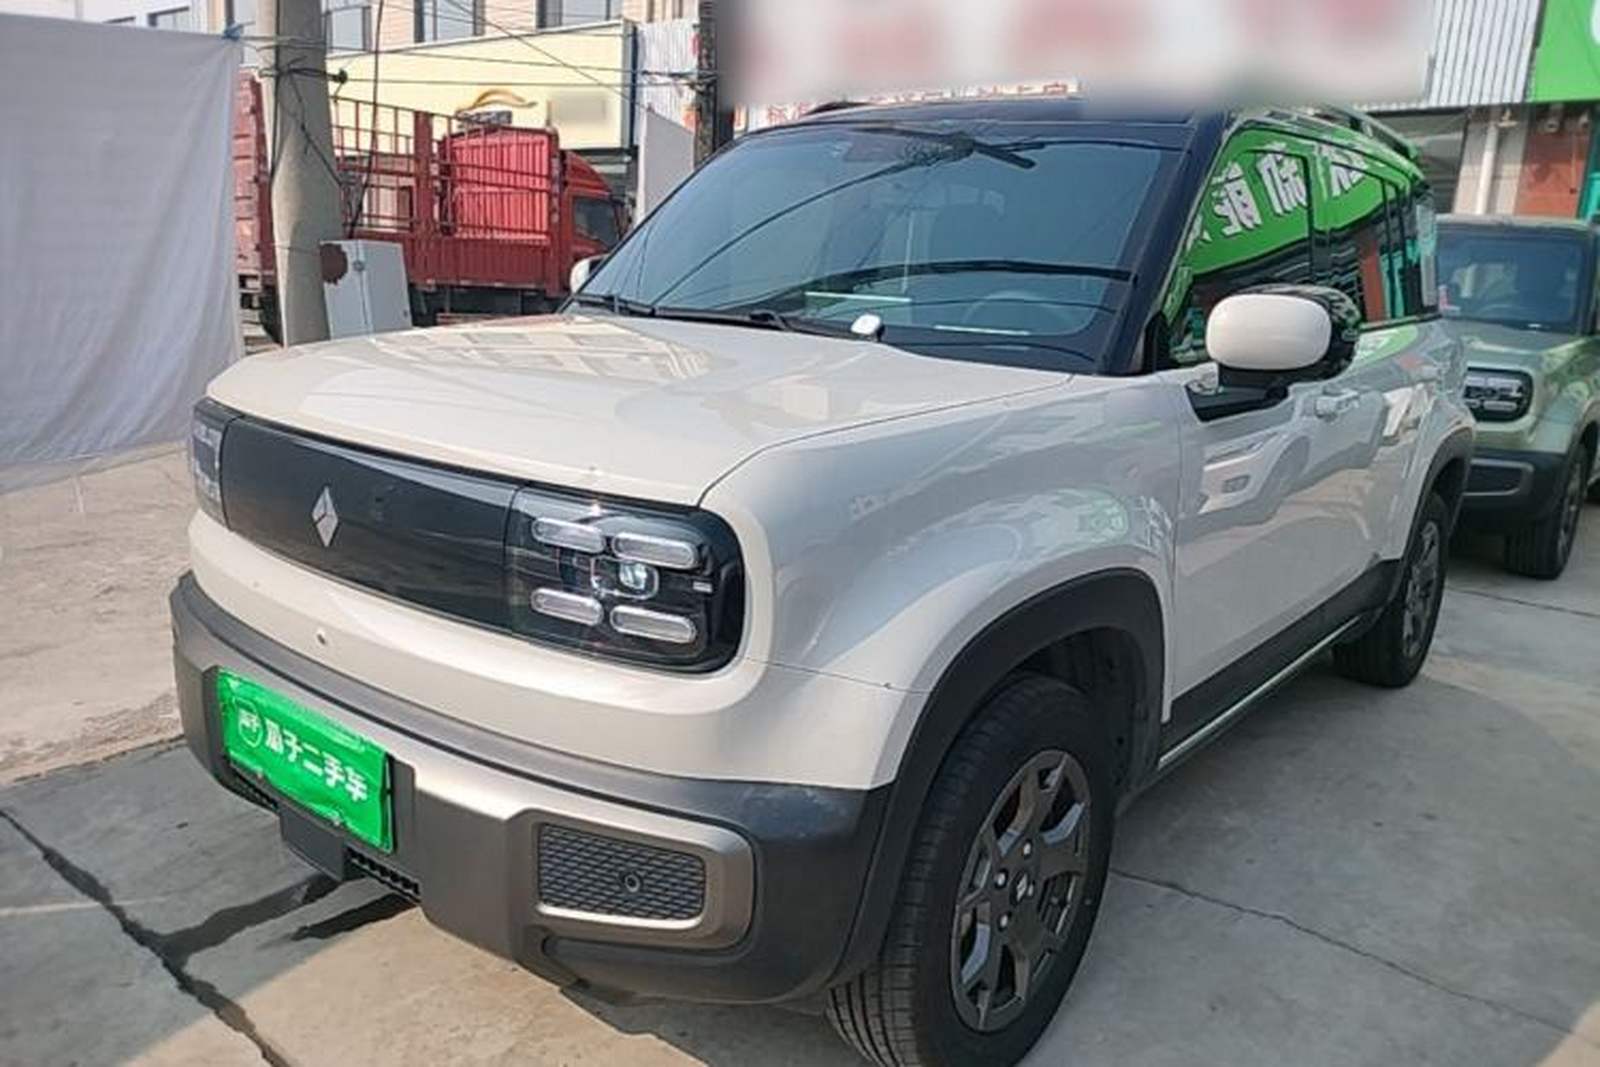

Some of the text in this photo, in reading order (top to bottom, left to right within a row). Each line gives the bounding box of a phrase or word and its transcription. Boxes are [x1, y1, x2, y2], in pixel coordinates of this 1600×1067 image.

[265, 720, 368, 802] 瓜子二手车
